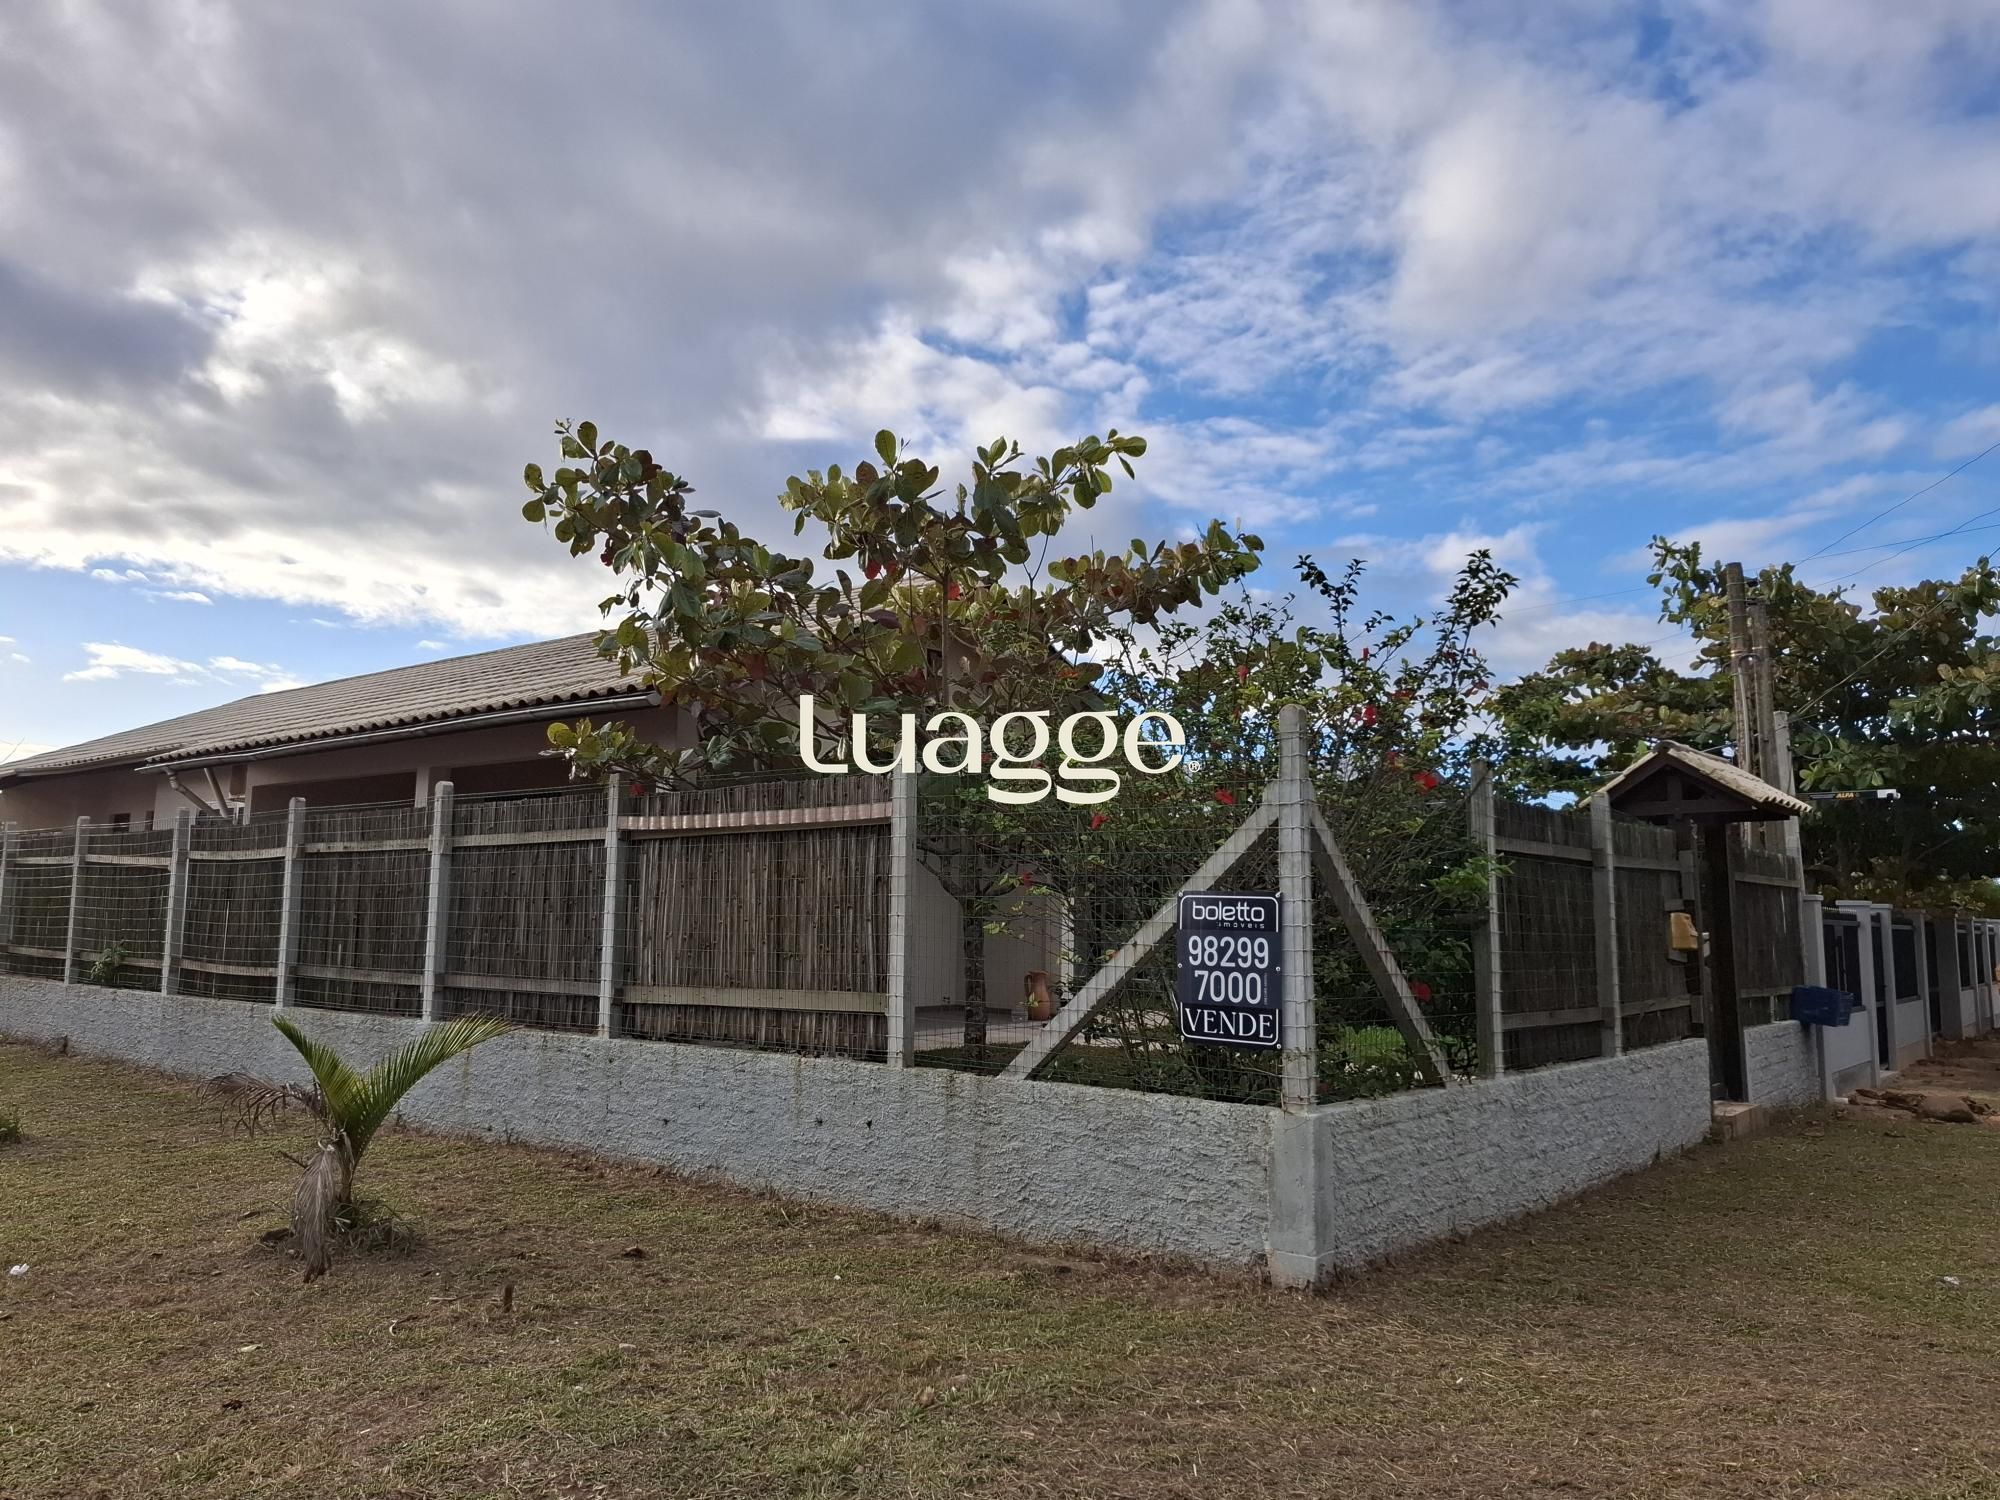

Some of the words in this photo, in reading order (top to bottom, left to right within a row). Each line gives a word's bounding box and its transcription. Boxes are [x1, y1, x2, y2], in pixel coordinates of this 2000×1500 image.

[1192, 901, 1265, 922] boletto
[1188, 935, 1269, 969] 98299
[1194, 970, 1262, 1005] 7000
[1185, 1008, 1273, 1038] VENDE
